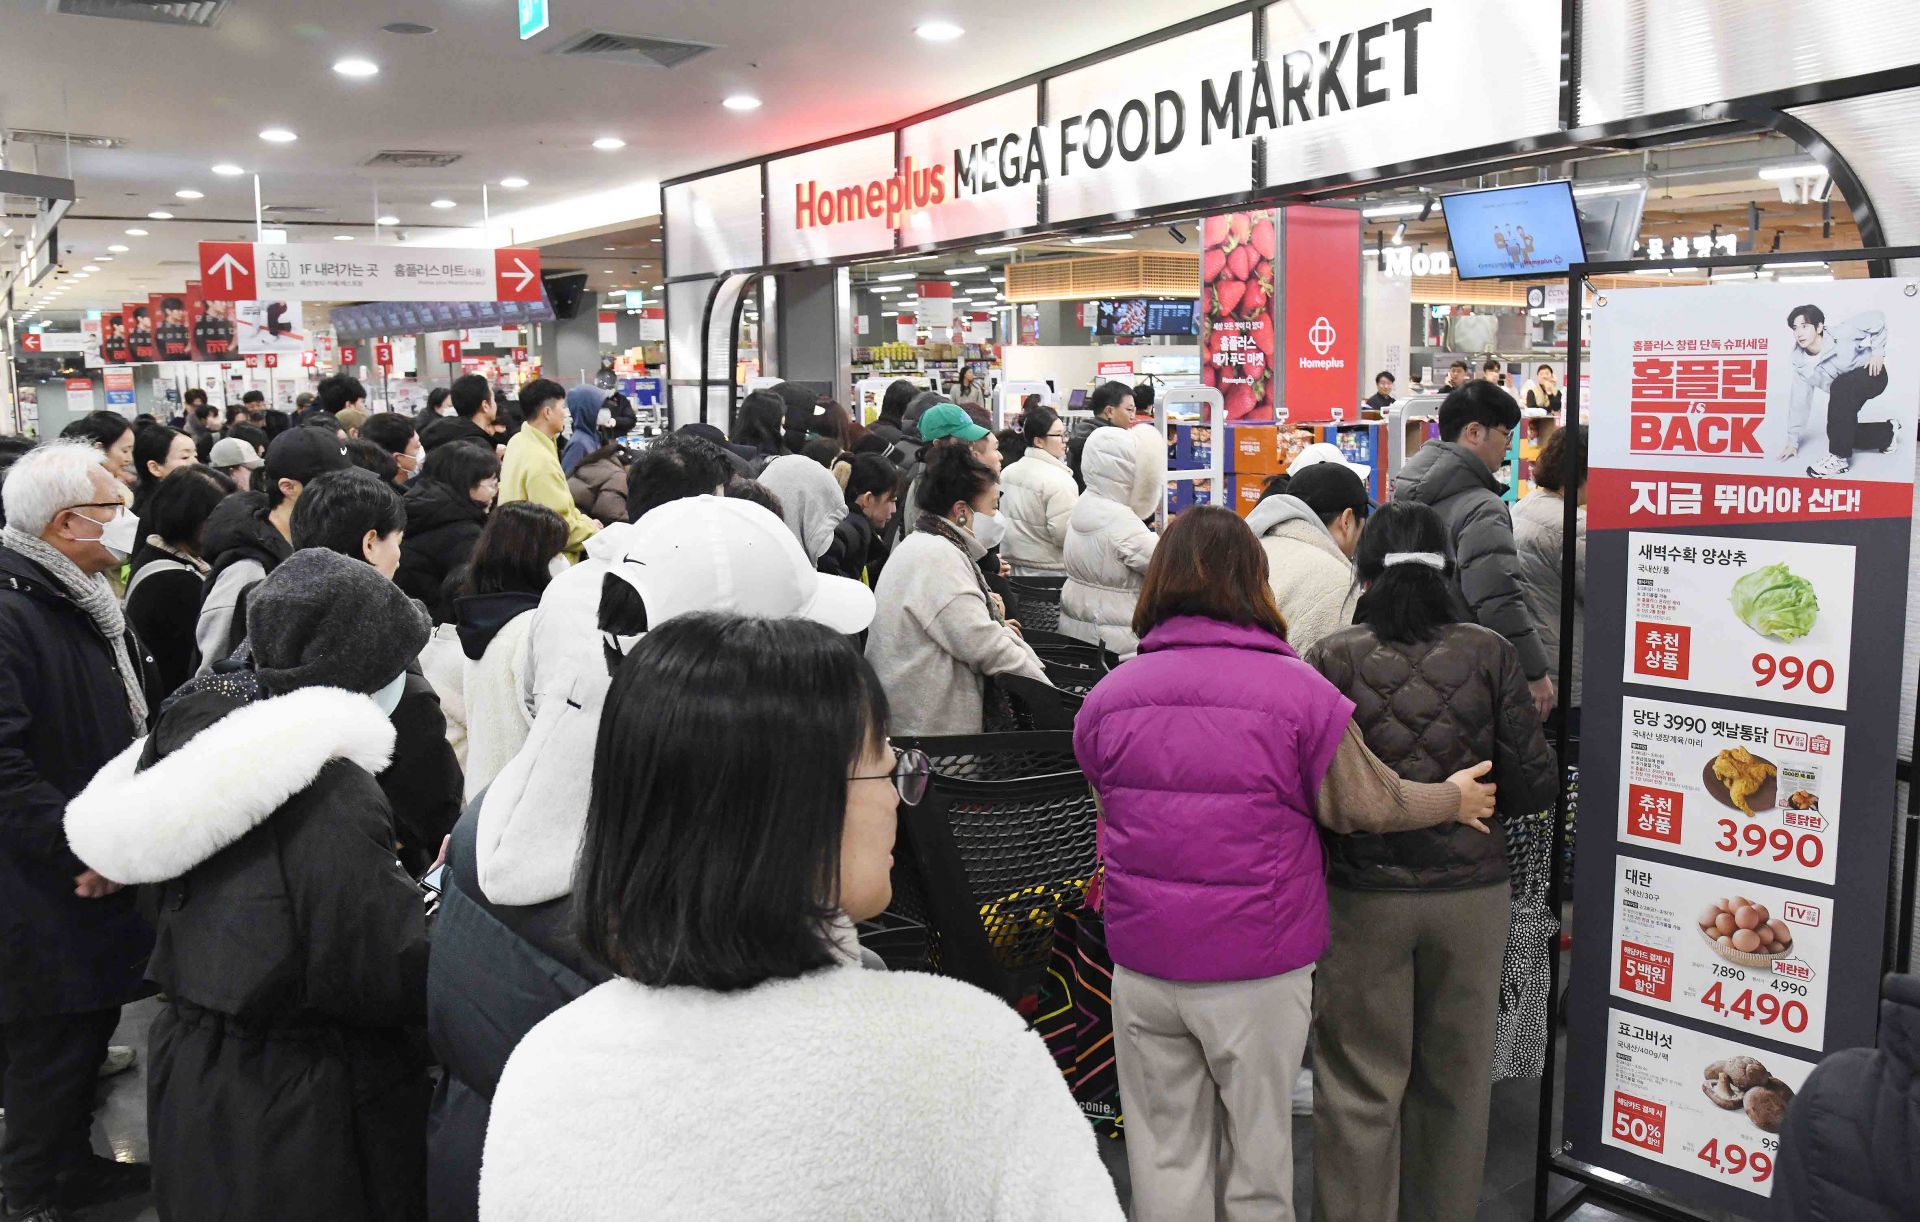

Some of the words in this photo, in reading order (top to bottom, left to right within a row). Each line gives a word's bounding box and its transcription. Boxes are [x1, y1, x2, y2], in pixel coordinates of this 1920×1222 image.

[796, 156, 945, 229] Homeplus
[954, 127, 1049, 199] MEGA
[1060, 89, 1186, 177] FOOD
[1201, 7, 1432, 145] MARKET
[300, 264, 311, 275] 1F
[315, 263, 364, 277] 내려가는
[367, 263, 379, 277] 곳
[394, 263, 440, 277] 홈플러스
[1381, 246, 1451, 277] Mon
[449, 344, 456, 357] 1
[1220, 335, 1256, 351] 홈플러스
[1633, 340, 1674, 351] 홈플러스
[1676, 339, 1697, 351] 창립
[1700, 339, 1721, 351] 단독
[1724, 338, 1768, 350] 슈퍼세일
[267, 355, 276, 365] 9
[304, 352, 313, 364] 7
[345, 350, 352, 361] 5
[381, 348, 389, 361] 3
[1212, 352, 1229, 366] 메가
[1230, 353, 1246, 367] 푸드
[1247, 352, 1264, 366] 마켓
[1299, 357, 1344, 370] Homeplus
[1632, 359, 1768, 399] 홈플런
[1687, 401, 1706, 414] is
[1630, 415, 1764, 453] BACK
[1630, 482, 1702, 514] 지금
[1714, 485, 1800, 514] 뛰어야
[1808, 488, 1861, 513] 산다!
[1638, 544, 1697, 563] 새벽수확
[1702, 548, 1748, 567] 양상추
[1638, 564, 1670, 575] 국내산/통
[1646, 630, 1679, 652] 추천
[1645, 650, 1679, 671] 상품
[1752, 653, 1834, 694] 990
[1634, 709, 1660, 727] 당당
[1663, 713, 1707, 734] 3990
[1711, 720, 1769, 744] 옛날통닭
[1632, 729, 1653, 741] 국내산
[1655, 733, 1703, 748] 냉장계육/마리
[1778, 733, 1794, 745] TV
[1639, 794, 1672, 816] 추천
[1638, 814, 1672, 835] 상품
[1785, 812, 1822, 829] 통닭런
[1715, 818, 1823, 868] 3,990
[1625, 869, 1652, 887] 대란
[1624, 887, 1660, 902] 국내산/30구
[1788, 906, 1806, 919] TV
[1649, 953, 1663, 963] 결제
[1664, 957, 1671, 966] 시
[1625, 959, 1666, 984] 5백원
[1712, 963, 1746, 981] 7,890
[1774, 961, 1809, 979] 계란런
[1635, 978, 1656, 994] 할인
[1770, 979, 1807, 997] 4,990
[1700, 981, 1809, 1034] 4,490
[1618, 1021, 1673, 1050] 표고버섯
[1617, 1040, 1669, 1061] 국내산/400g/팩
[1655, 1110, 1663, 1118] 시
[1615, 1111, 1661, 1142] 50%
[1647, 1137, 1660, 1147] 할인
